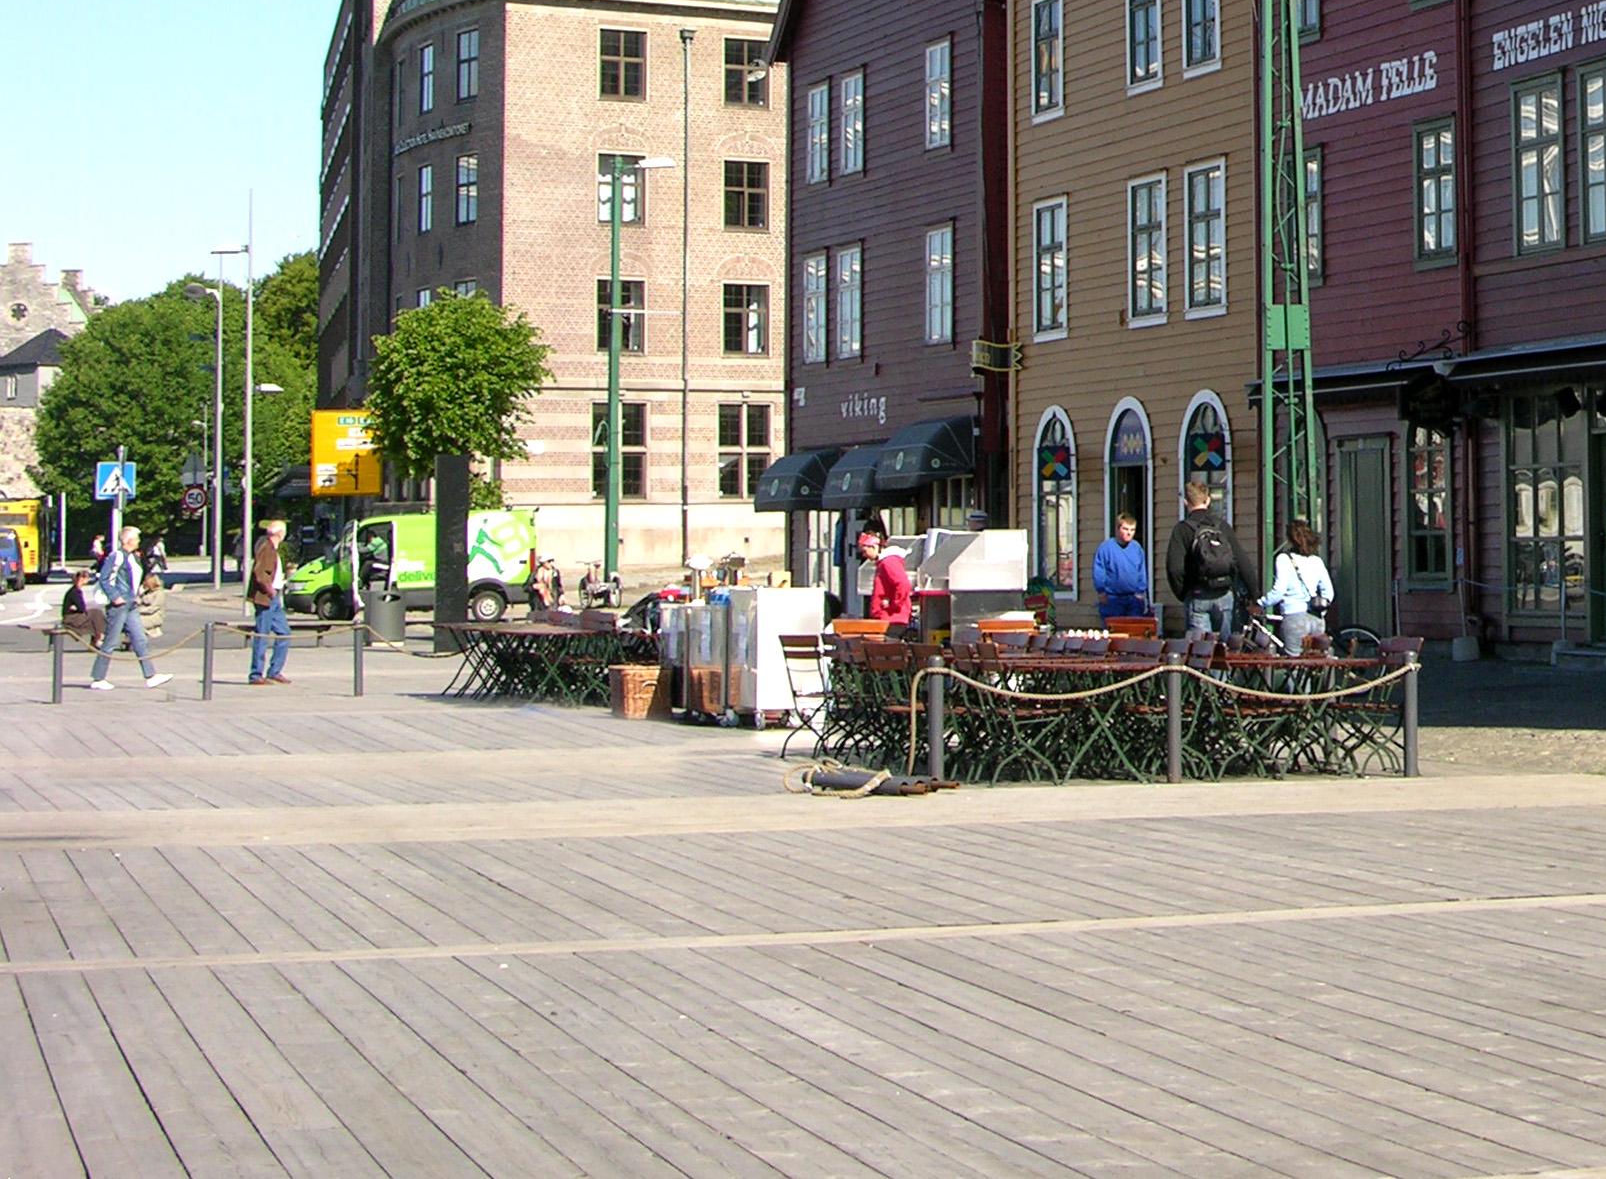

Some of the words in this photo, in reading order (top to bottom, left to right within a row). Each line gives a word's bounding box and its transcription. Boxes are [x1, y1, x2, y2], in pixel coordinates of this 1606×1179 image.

[1492, 10, 1573, 71] ENGELEN
[1300, 67, 1374, 120] MADAM
[1380, 50, 1438, 103] FELLE
[841, 393, 887, 424] viking
[188, 492, 203, 504] 50
